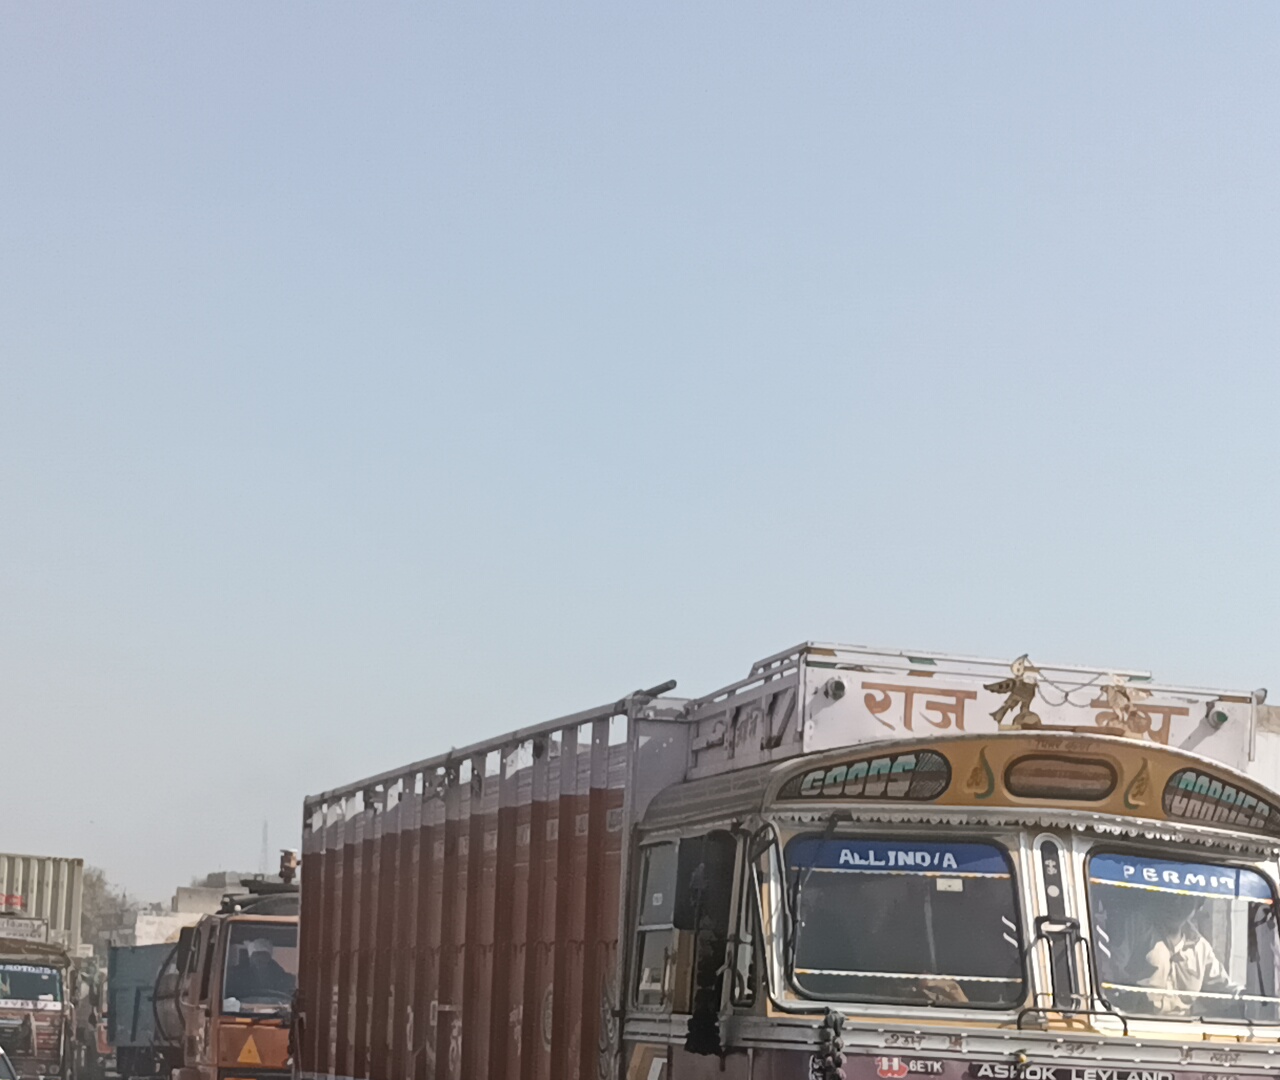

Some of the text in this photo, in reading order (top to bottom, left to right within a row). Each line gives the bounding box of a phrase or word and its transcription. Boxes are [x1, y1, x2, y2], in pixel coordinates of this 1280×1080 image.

[861, 681, 978, 732] राज
[801, 754, 917, 798] GOODS
[1123, 864, 1237, 891] PERMIT
[909, 1060, 943, 1073] 6ETK
